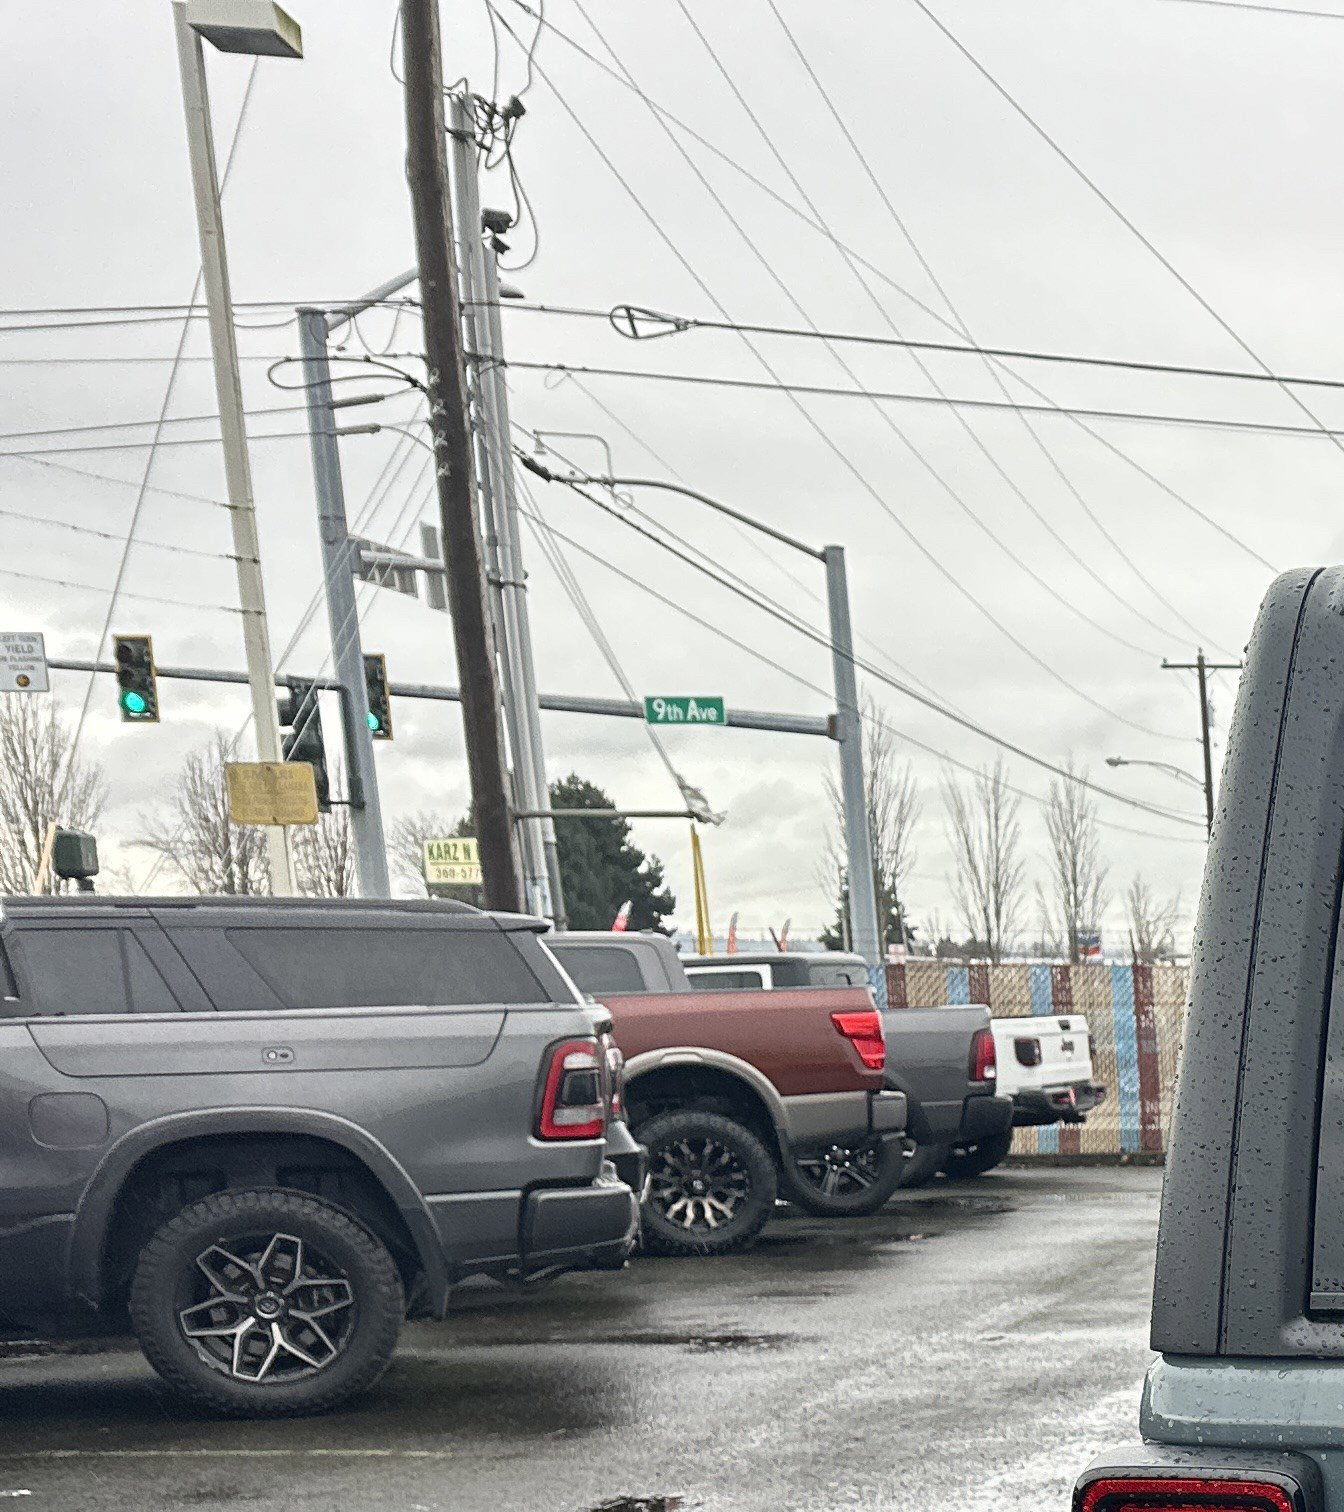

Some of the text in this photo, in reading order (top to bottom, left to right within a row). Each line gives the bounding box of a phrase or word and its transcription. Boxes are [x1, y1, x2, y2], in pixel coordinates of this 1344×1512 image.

[5, 644, 34, 654] YIELD
[652, 698, 718, 721] 9th Ave
[427, 842, 459, 861] KARZ
